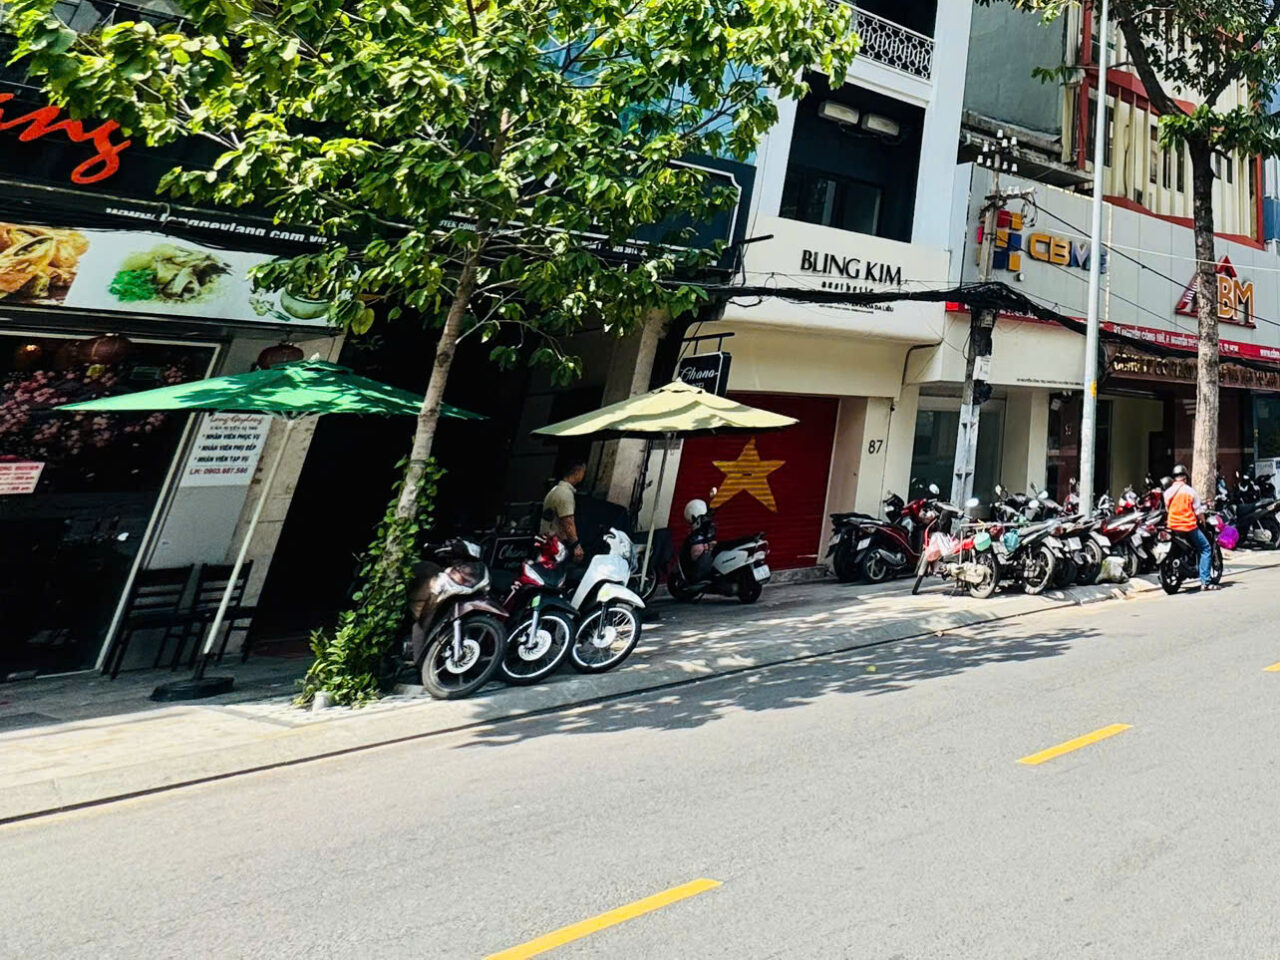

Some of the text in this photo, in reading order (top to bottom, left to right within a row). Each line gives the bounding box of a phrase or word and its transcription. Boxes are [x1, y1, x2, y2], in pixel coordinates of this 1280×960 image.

[801, 249, 902, 286] BLING KIM
[868, 440, 883, 454] 87
